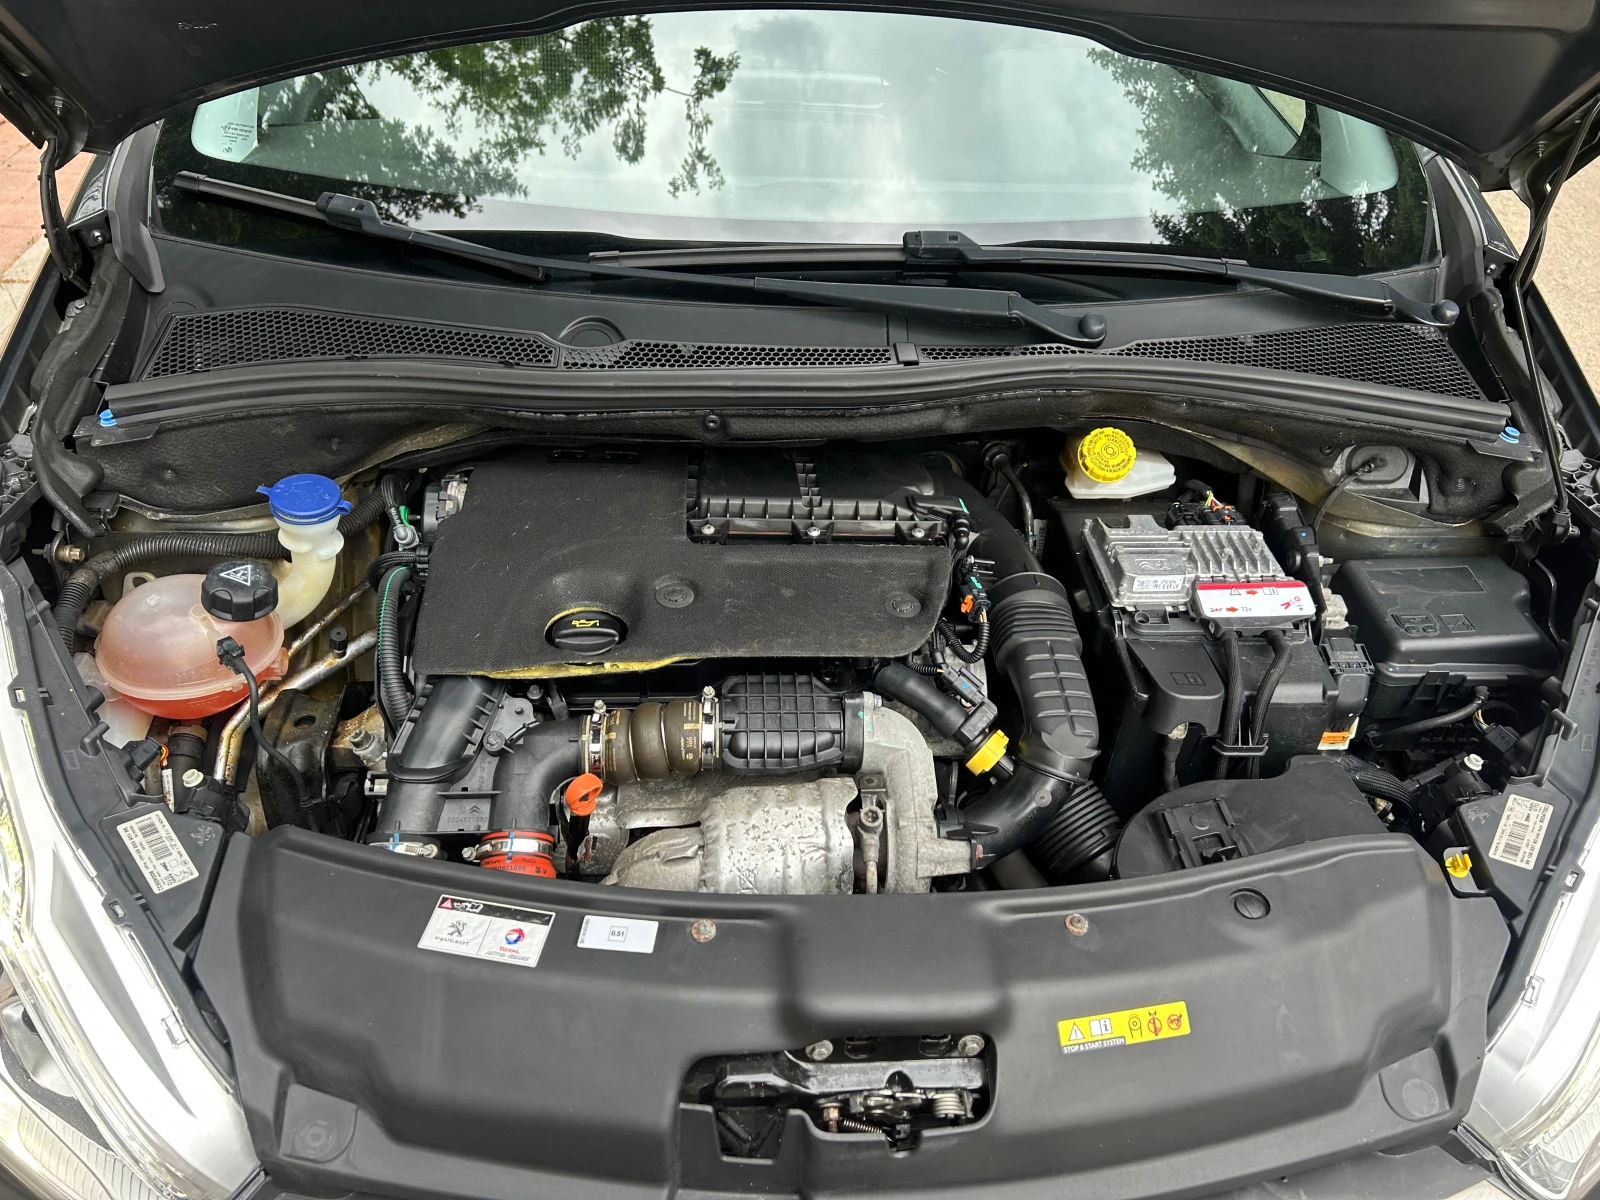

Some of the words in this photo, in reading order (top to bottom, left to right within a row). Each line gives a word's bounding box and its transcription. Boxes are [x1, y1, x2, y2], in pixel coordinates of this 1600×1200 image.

[434, 936, 470, 945] PEUGEOT
[500, 946, 520, 954] TOTAL
[1064, 1045, 1079, 1053] STOP
[1084, 1041, 1102, 1050] START
[1103, 1037, 1125, 1047] SYSTEM
